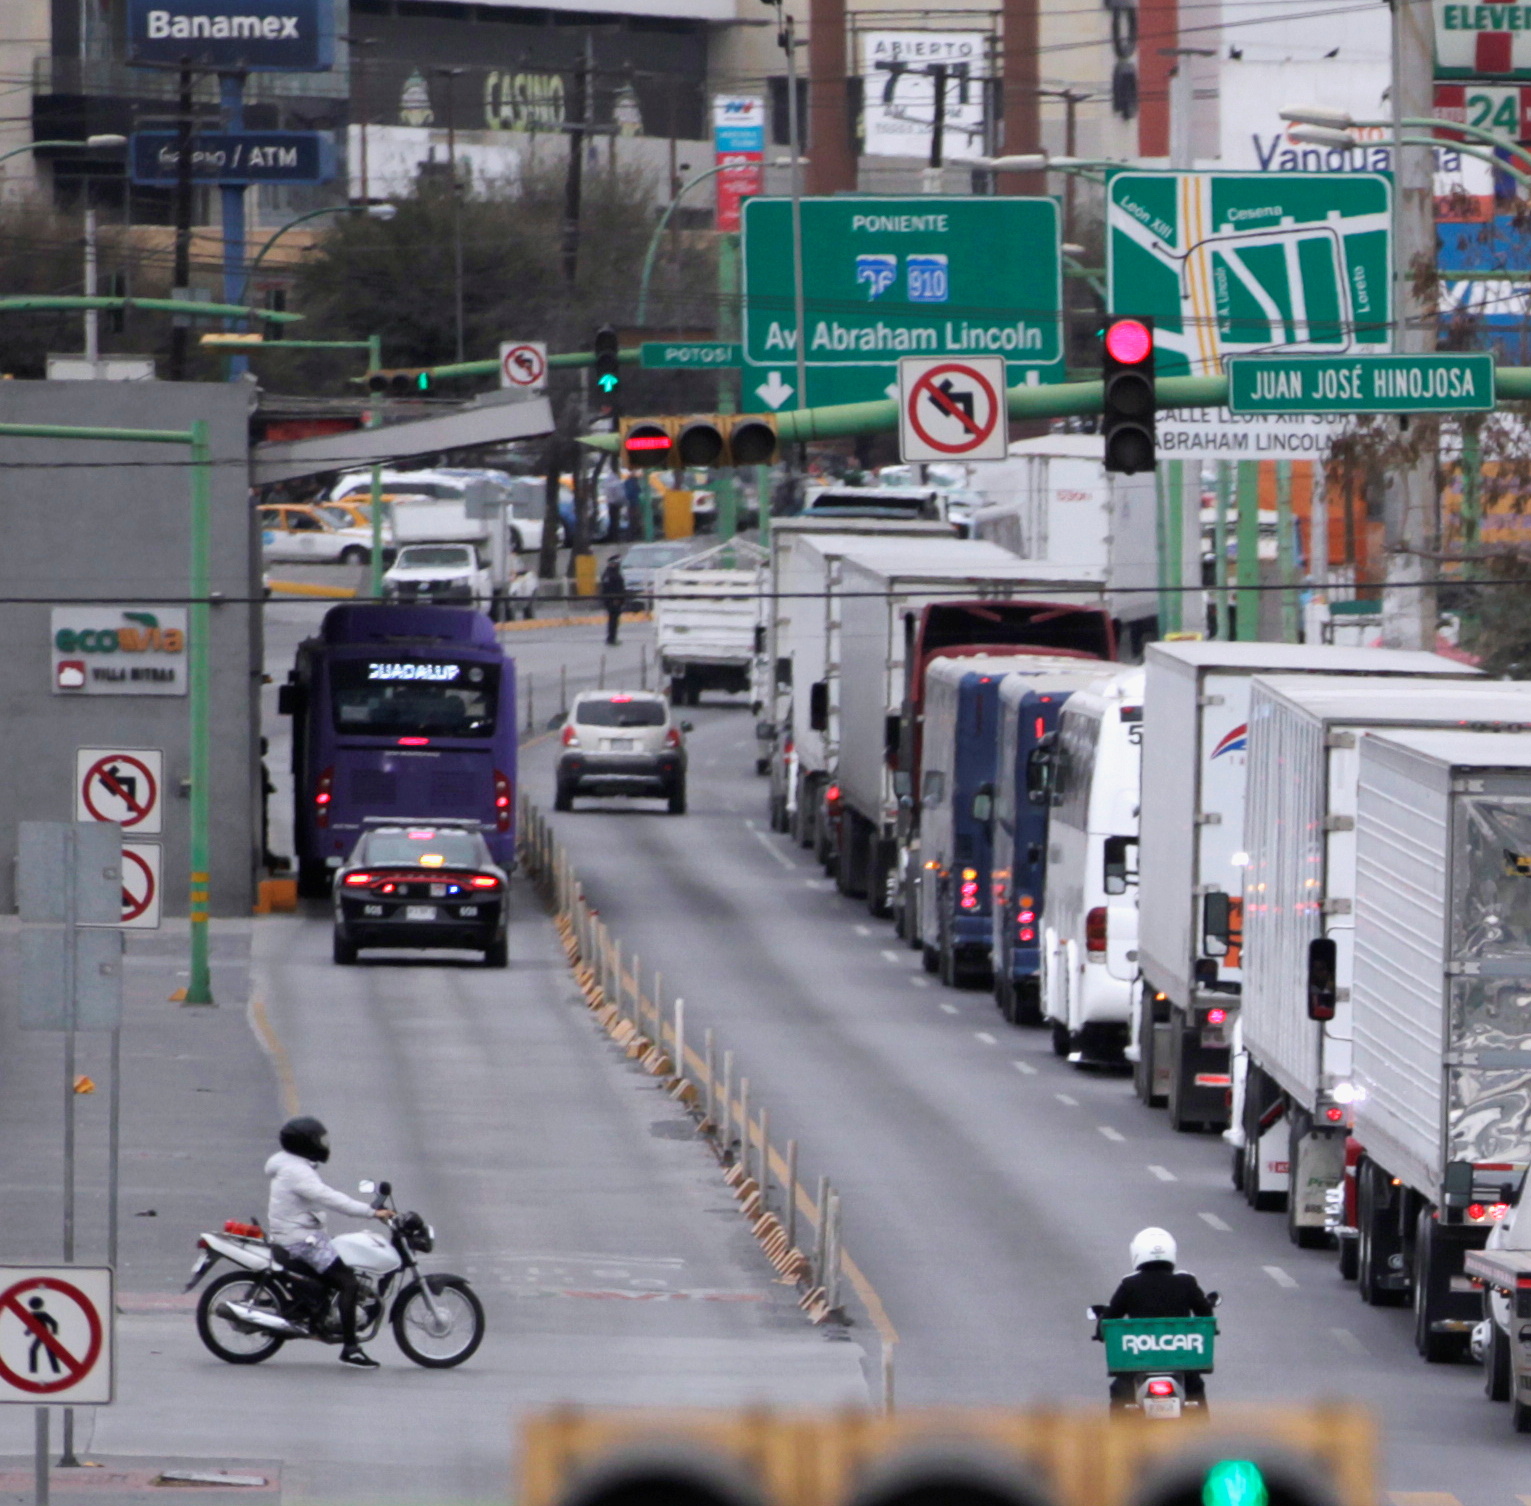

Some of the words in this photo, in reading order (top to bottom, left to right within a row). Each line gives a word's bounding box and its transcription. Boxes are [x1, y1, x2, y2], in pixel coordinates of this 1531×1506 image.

[146, 10, 299, 39] Banamex
[874, 39, 974, 56] ABIERTO
[874, 61, 909, 103] 7
[485, 71, 566, 131] CASINO
[1467, 94, 1520, 134] 24
[248, 147, 298, 167] ATM
[1120, 195, 1151, 223] León
[1227, 204, 1283, 222] Cesena
[852, 215, 948, 232] PONIENTE
[1151, 217, 1174, 239] XIII
[911, 270, 946, 297] 910
[1354, 266, 1371, 314] Loreto
[811, 321, 937, 350] Abraham
[946, 321, 1043, 350] Lincoln
[1251, 370, 1303, 399] JUAN
[1312, 364, 1363, 399] JOSÉ
[1374, 368, 1475, 398] HINOJOSA
[1154, 432, 1250, 451] ABRAHAM
[1122, 1334, 1204, 1354] ROLCAR
